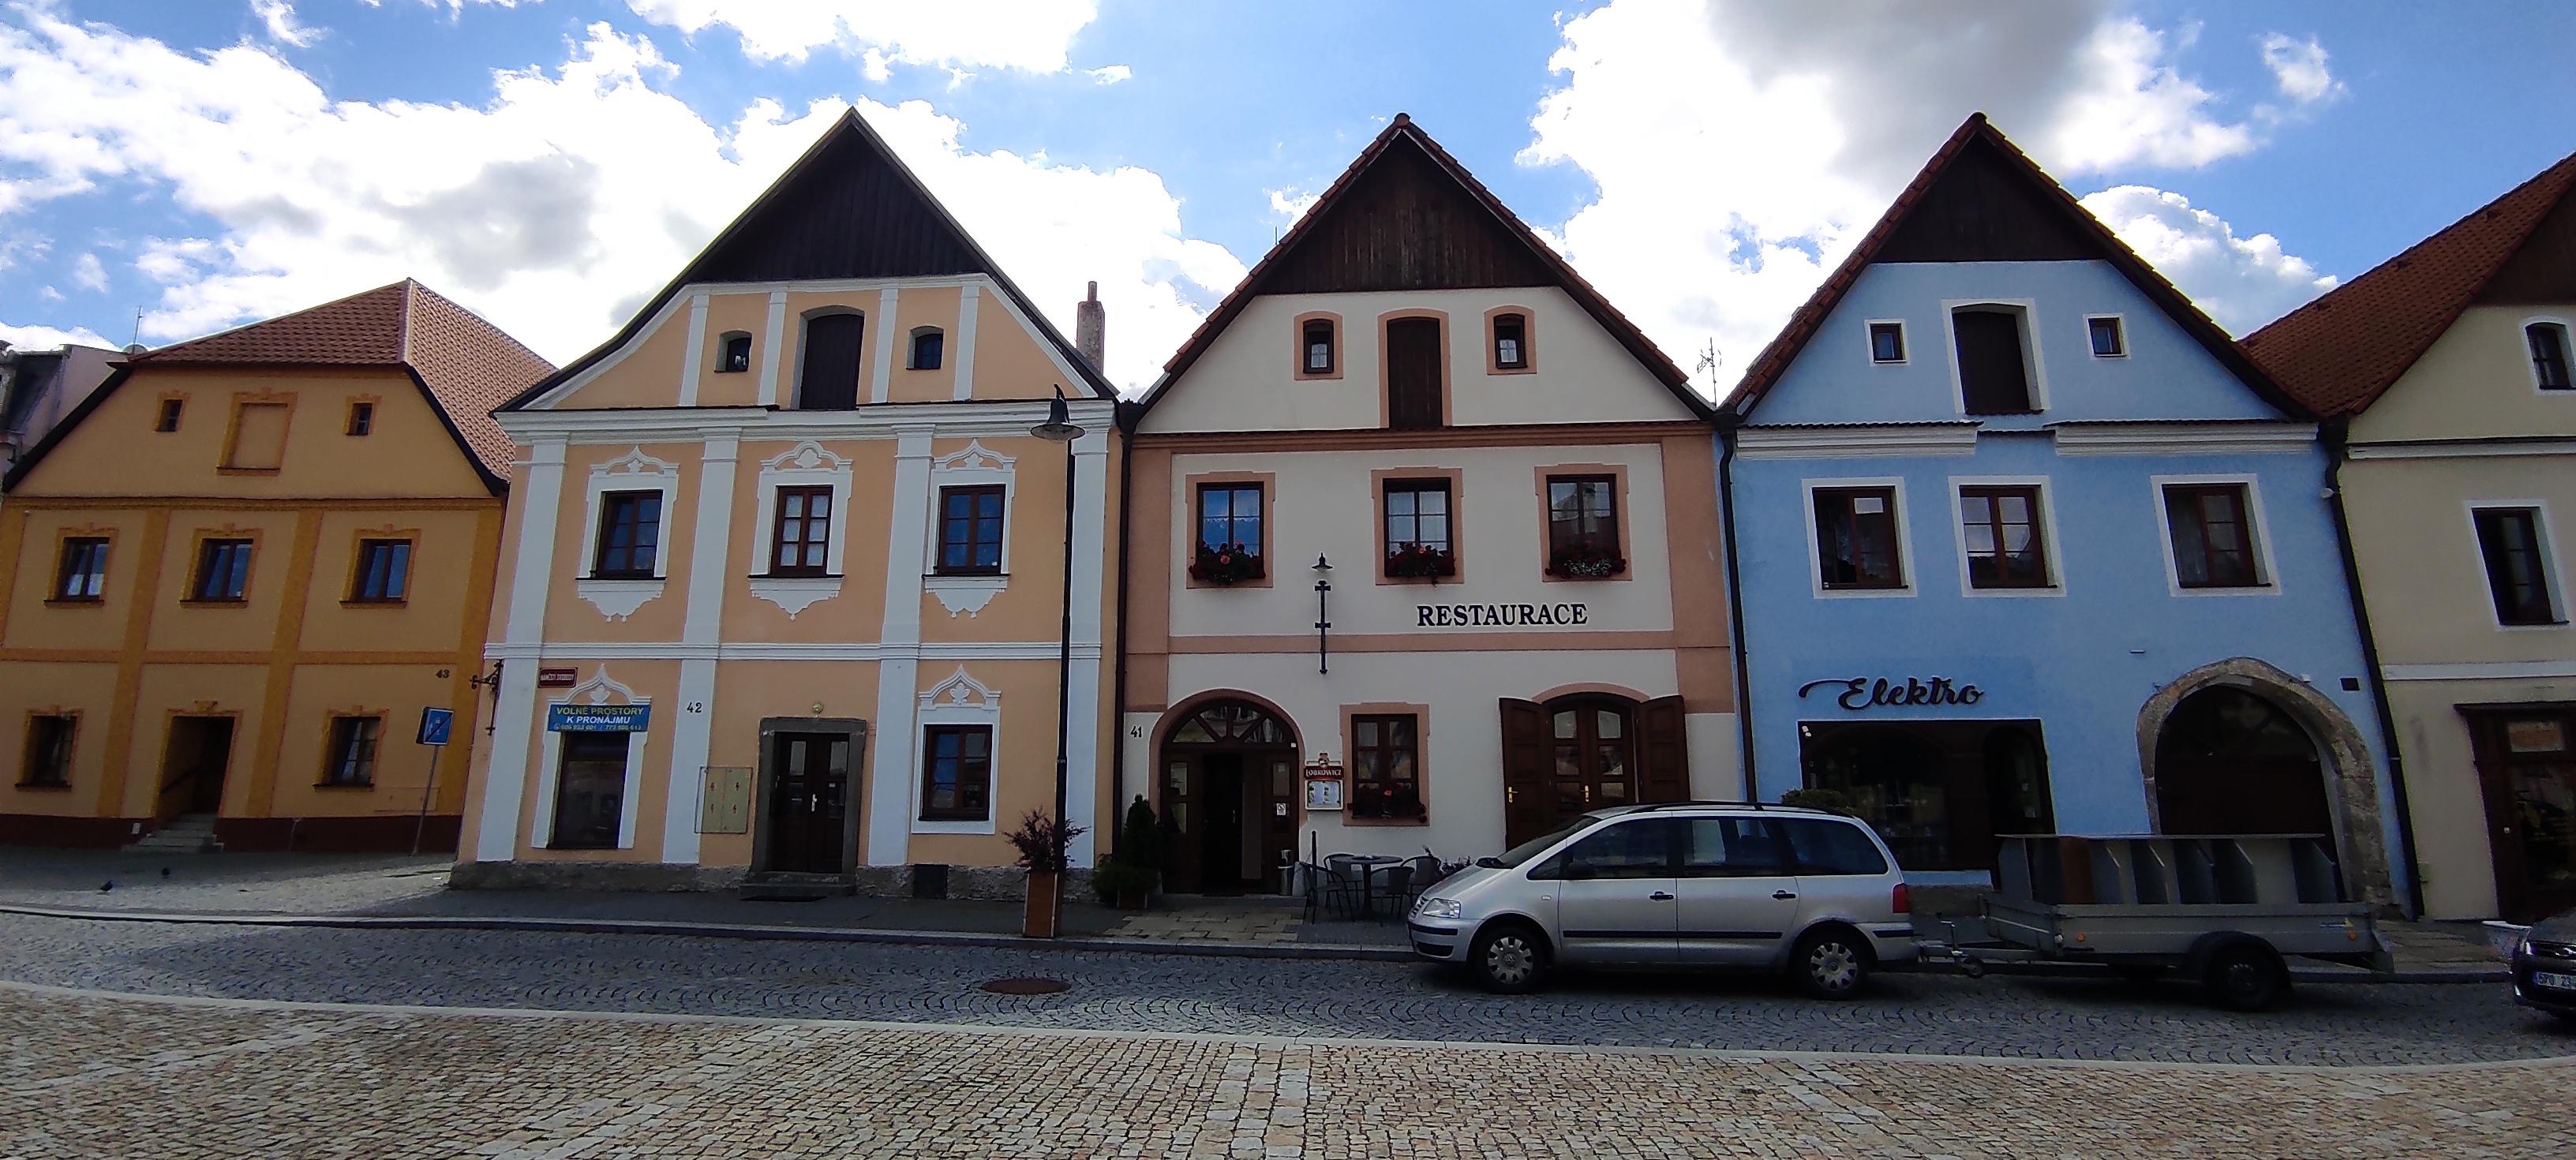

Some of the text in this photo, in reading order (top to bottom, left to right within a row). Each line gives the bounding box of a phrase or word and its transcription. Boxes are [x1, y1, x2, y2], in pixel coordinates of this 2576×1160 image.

[1417, 604, 1588, 627] RESTAURACE
[436, 669, 450, 679] 43
[1798, 675, 1984, 711] Elektro
[556, 706, 588, 715] VOLNÉ
[687, 702, 702, 713] 42
[576, 714, 631, 724] PRONÁJMU
[1129, 725, 1143, 738] 41
